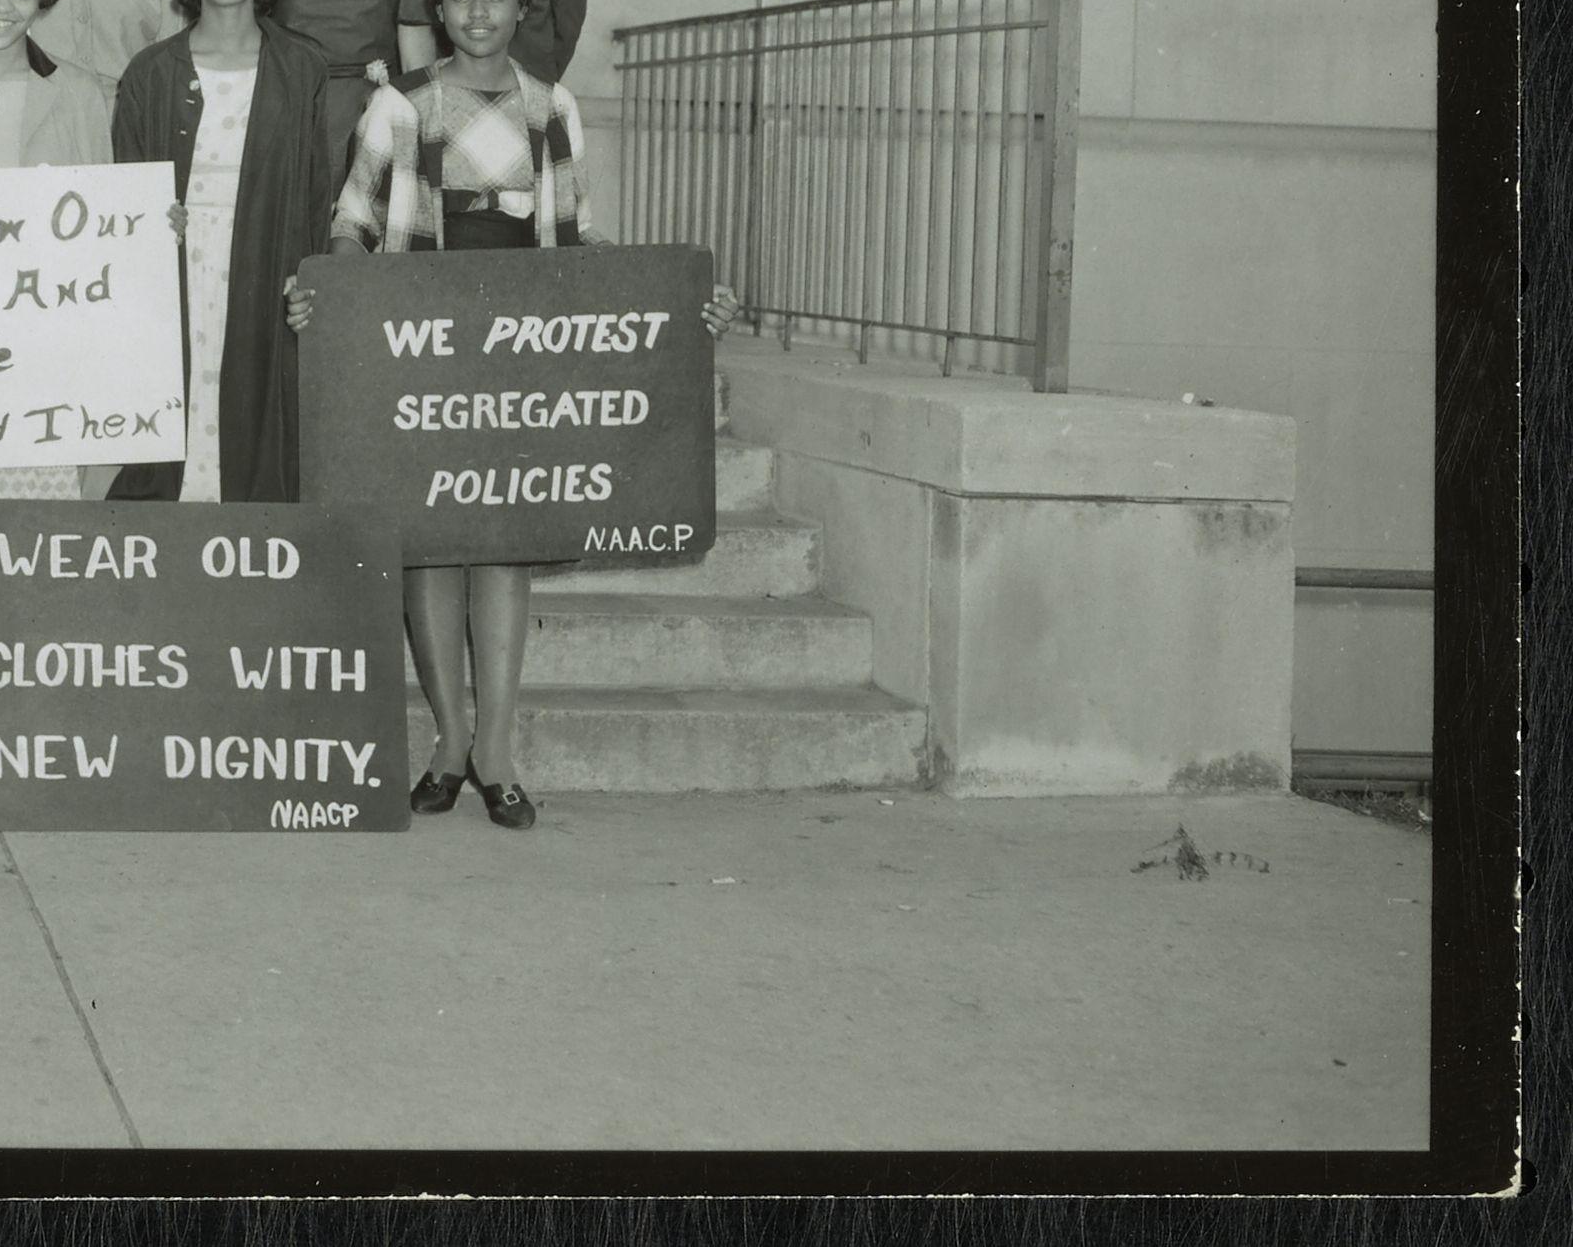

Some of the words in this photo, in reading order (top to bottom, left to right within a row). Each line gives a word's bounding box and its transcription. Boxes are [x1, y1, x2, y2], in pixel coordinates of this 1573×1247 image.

[50, 190, 145, 242] Our
[382, 318, 455, 358] WE
[482, 311, 670, 355] PROTEST
[393, 389, 649, 431] SEGREGATED
[425, 462, 613, 507] POLICIES
[201, 536, 300, 580] OLD
[229, 646, 366, 692] WITH
[163, 735, 381, 788] DIGNITY.
[270, 799, 359, 830] NAACP
